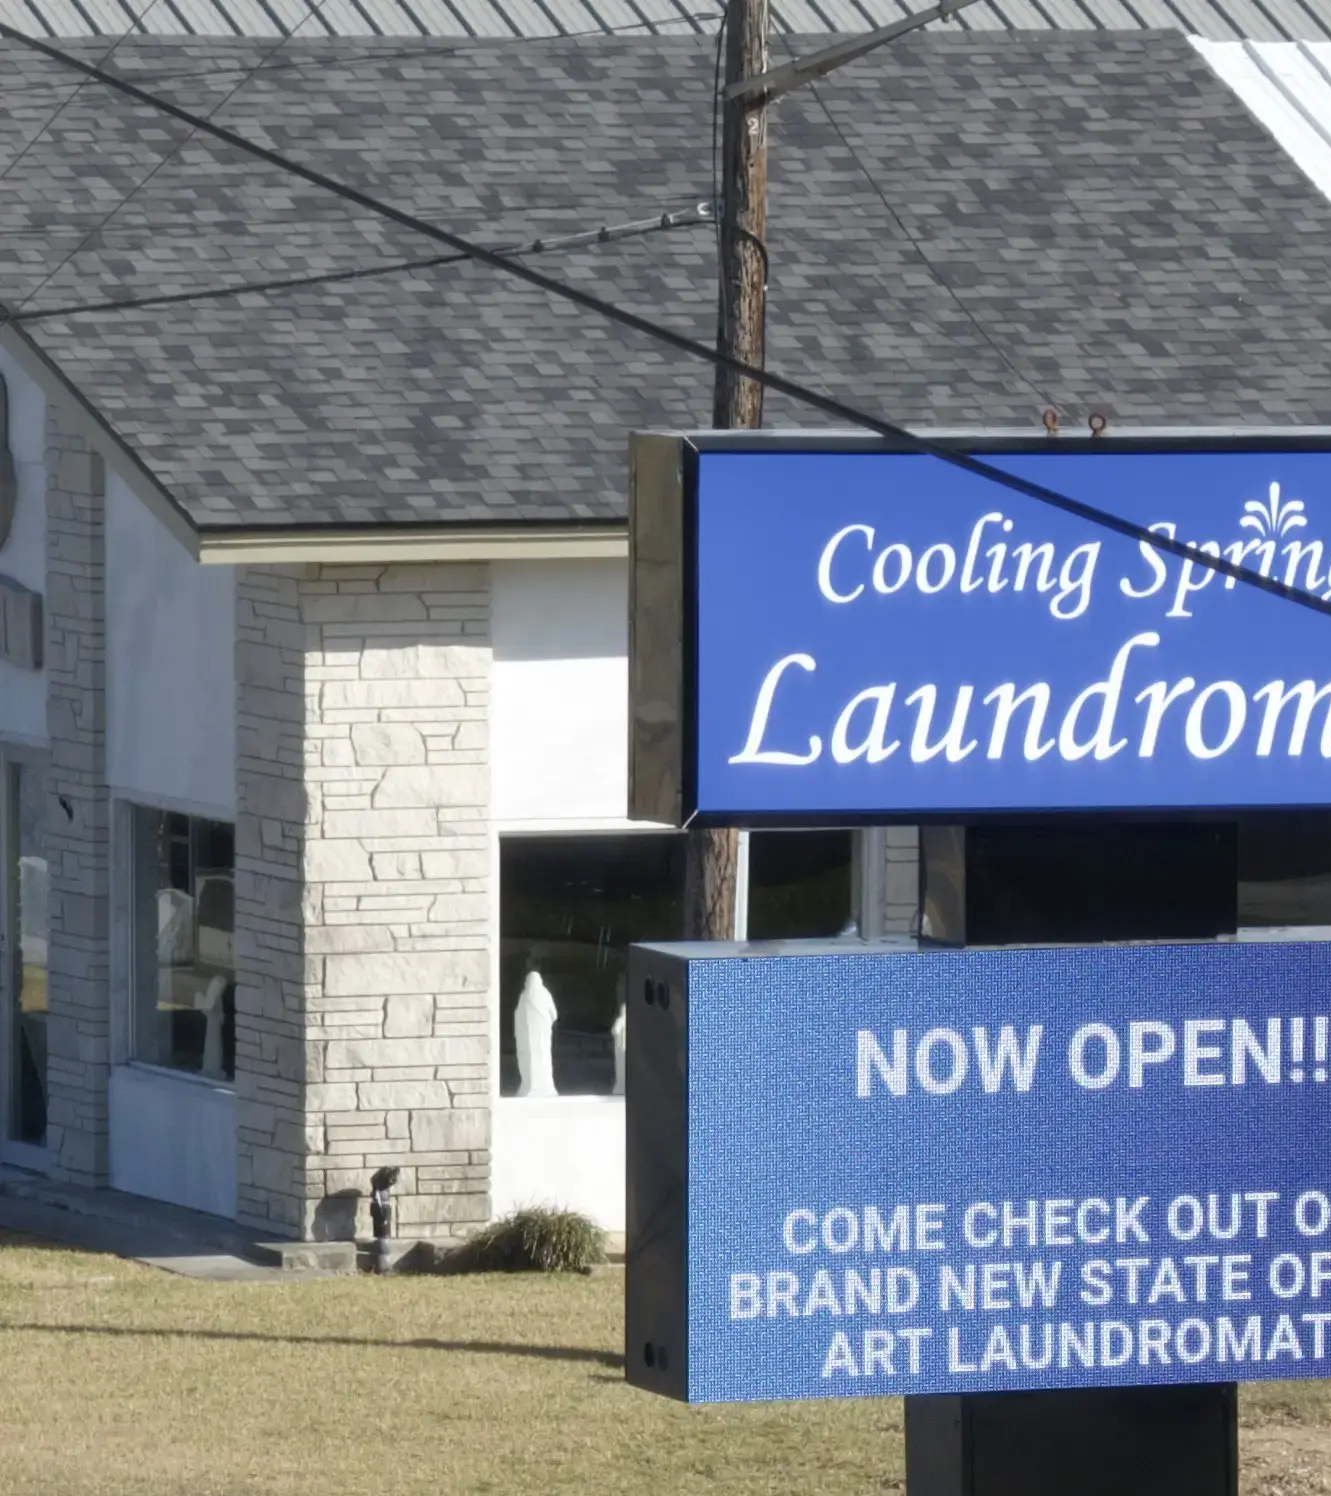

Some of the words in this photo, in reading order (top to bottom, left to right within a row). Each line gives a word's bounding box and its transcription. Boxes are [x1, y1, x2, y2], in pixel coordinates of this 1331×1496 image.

[817, 511, 1102, 620] Cooling
[855, 1023, 1041, 1098] NOW
[782, 1203, 946, 1254] COME
[963, 1195, 1150, 1249] CHECK
[1166, 1191, 1280, 1241] OUT
[729, 1266, 920, 1319] BRAND
[938, 1261, 1063, 1311] NEW
[1079, 1254, 1252, 1305] STATE
[820, 1326, 933, 1378] ART
